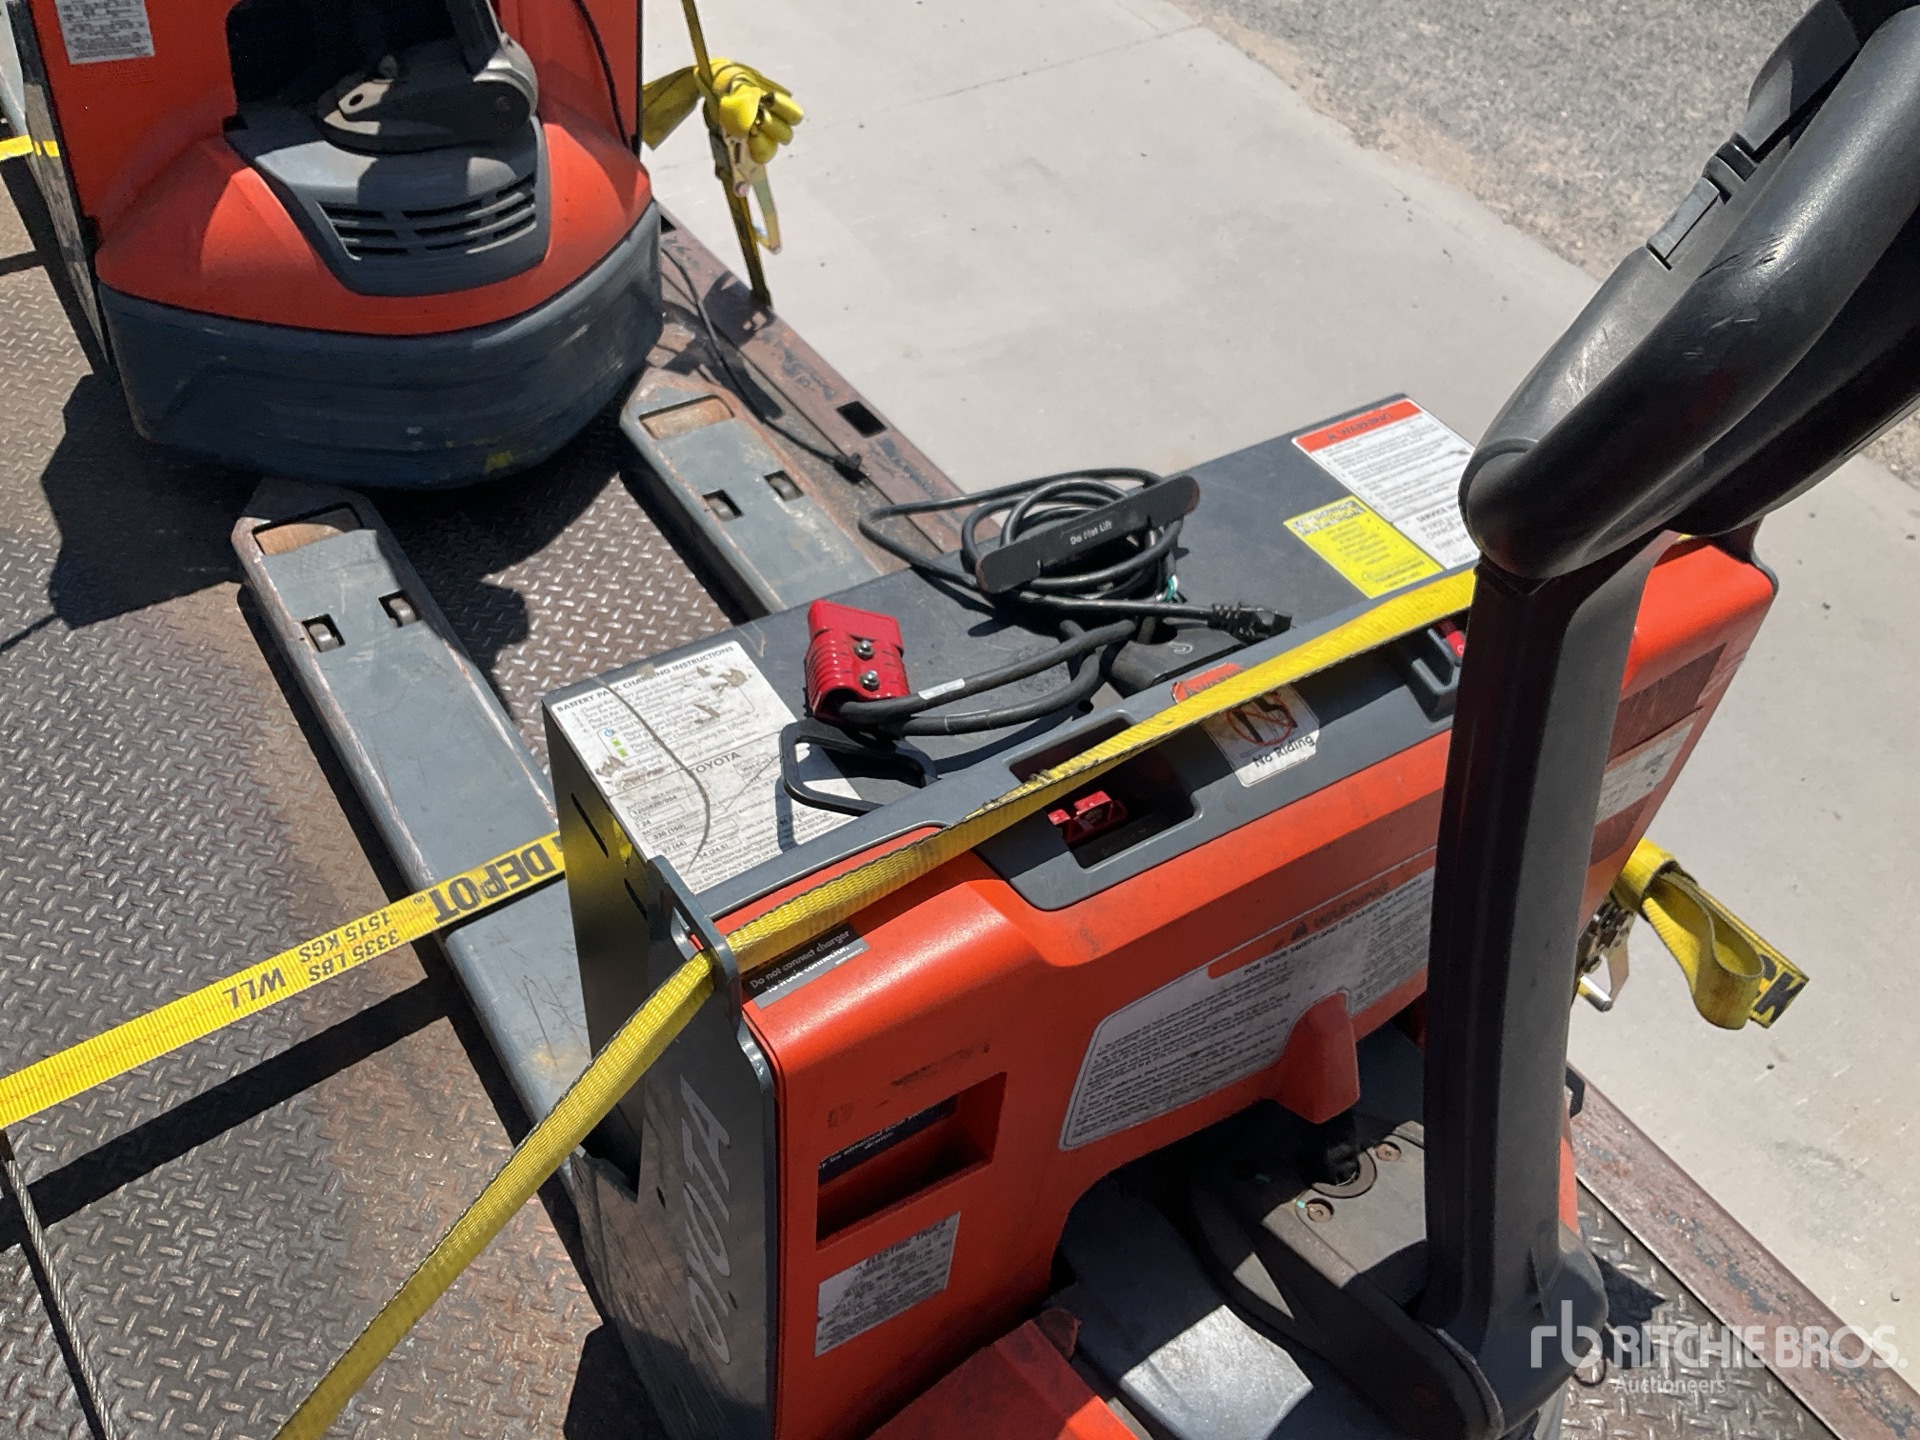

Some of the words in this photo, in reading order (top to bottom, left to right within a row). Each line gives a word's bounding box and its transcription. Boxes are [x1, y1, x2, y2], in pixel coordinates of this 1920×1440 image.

[1070, 534, 1082, 546] Do
[1083, 527, 1099, 541] Not
[1099, 520, 1113, 534] Lift
[555, 694, 596, 712] BATTERY
[594, 684, 622, 698] PAK
[620, 667, 671, 688] CHANG
[670, 645, 735, 671] INSTRUCTIONS
[1252, 754, 1273, 769] No
[1274, 735, 1315, 757] Riding
[344, 911, 392, 943] 1515
[299, 933, 340, 964] KGS
[351, 929, 400, 961] 3335
[750, 977, 765, 989] Do
[766, 968, 782, 980] not
[782, 948, 815, 972] connect
[816, 930, 850, 954] charger
[309, 952, 347, 982] LBS
[222, 967, 286, 1010] WLL
[680, 1074, 732, 1364] OYOTA
